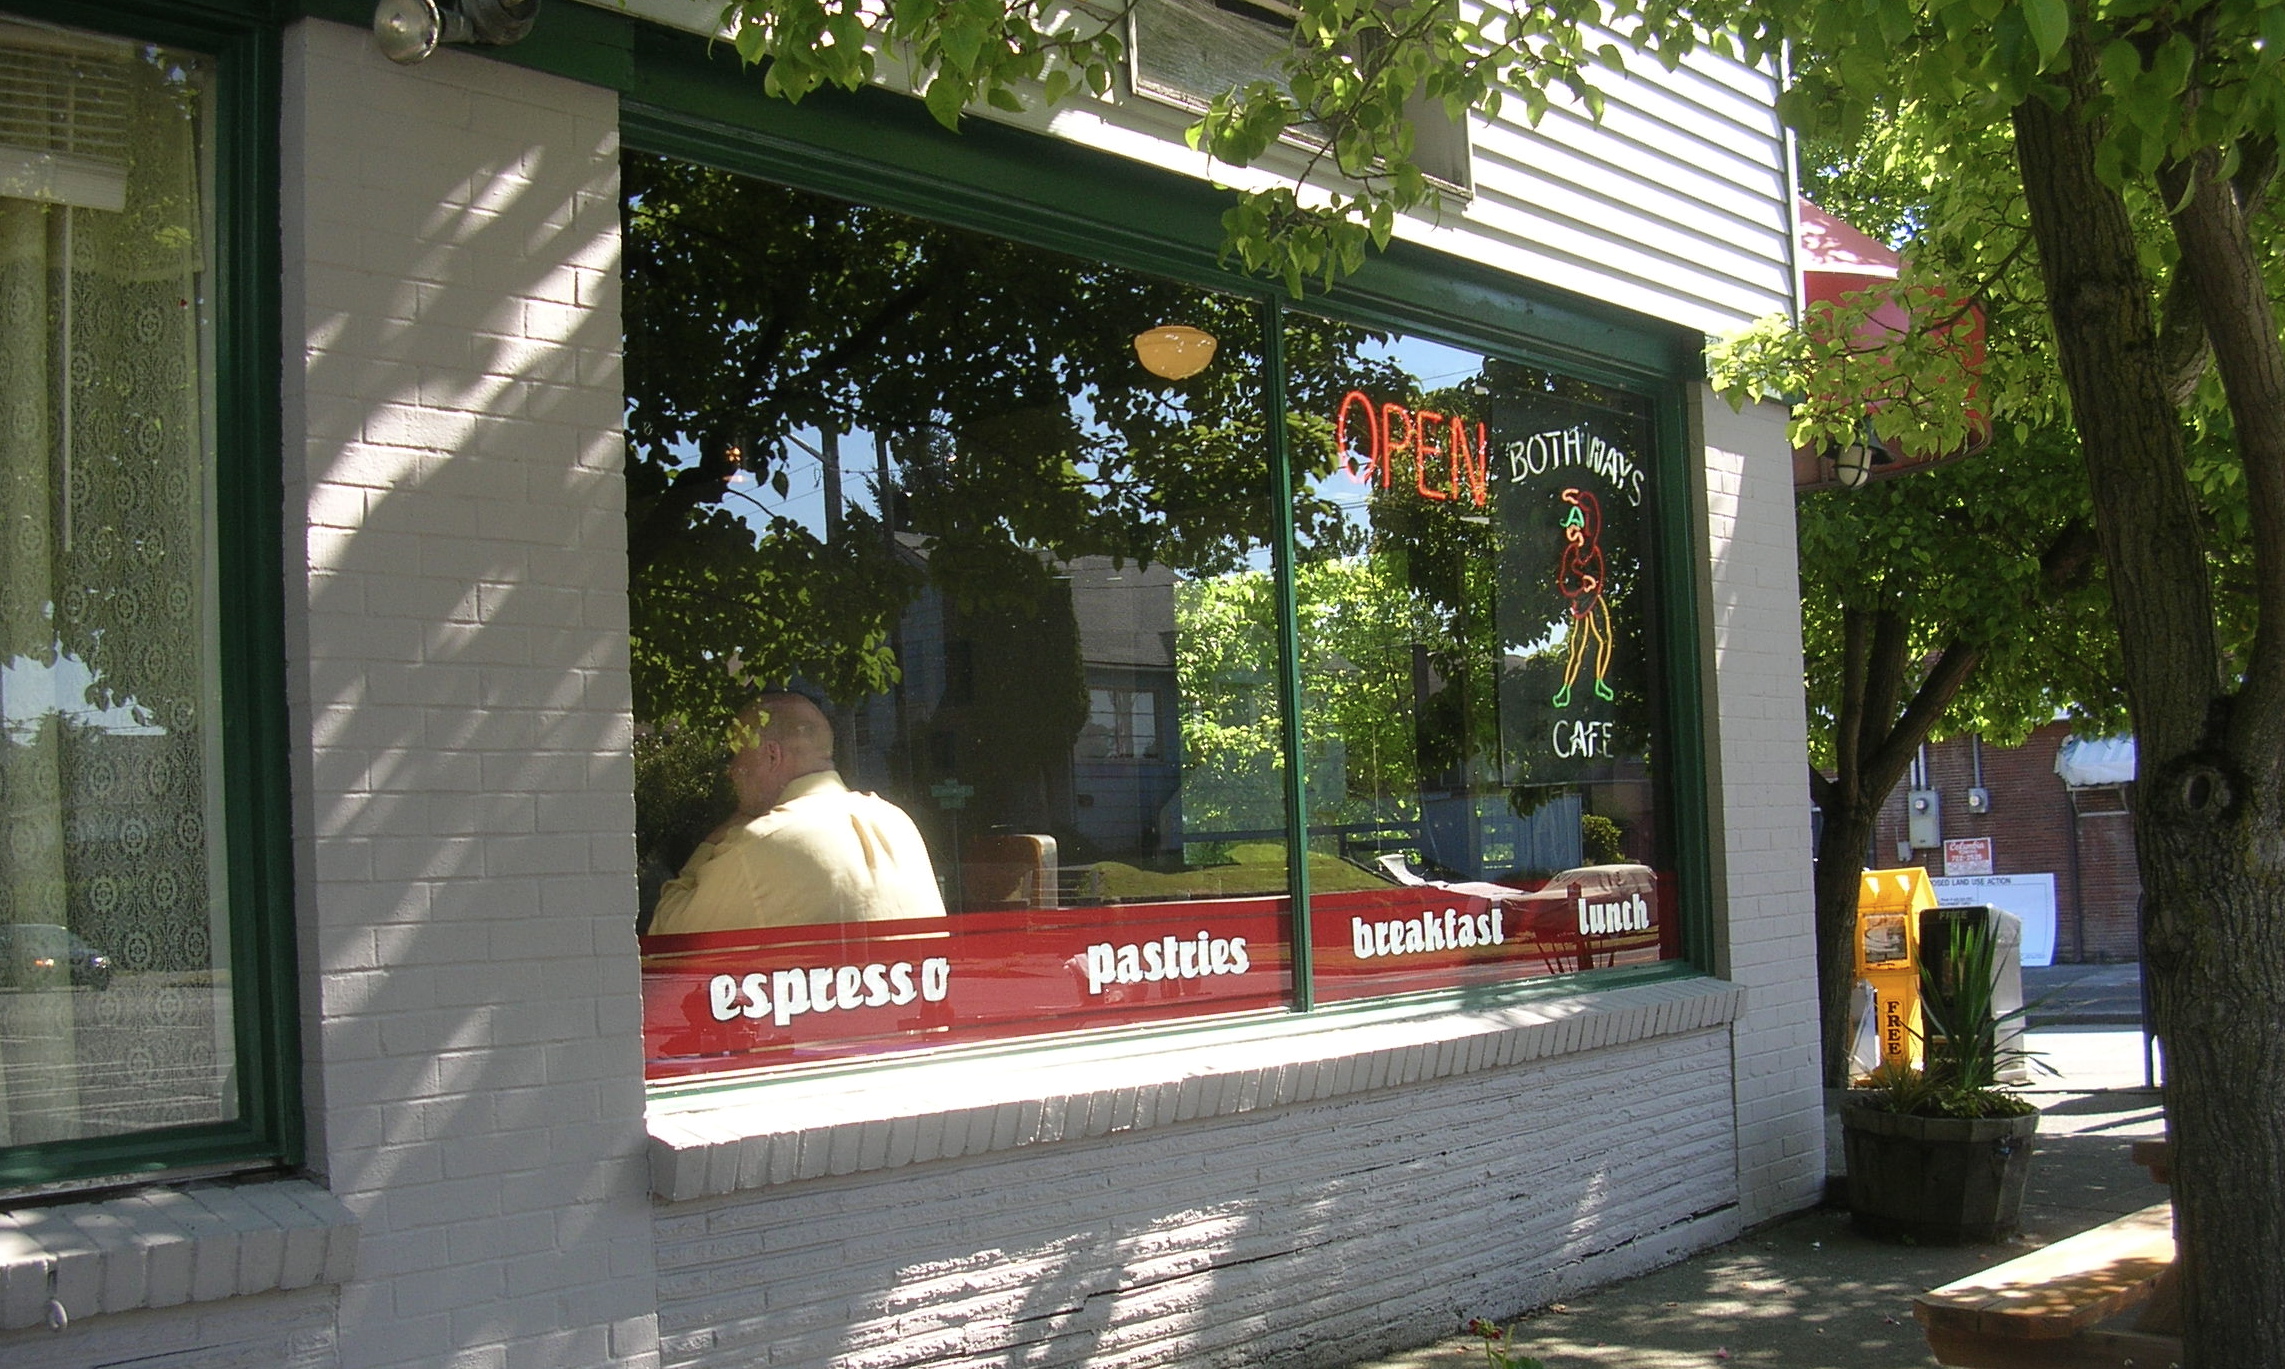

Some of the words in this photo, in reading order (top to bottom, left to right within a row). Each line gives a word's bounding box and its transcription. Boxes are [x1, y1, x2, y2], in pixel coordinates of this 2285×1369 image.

[1338, 390, 1486, 507] OPEN
[1507, 429, 1582, 483] BOTH
[1586, 431, 1645, 507] WAYS
[1553, 719, 1614, 759] CAFE
[1951, 878, 1970, 887] LAND
[1971, 877, 1984, 886] USE
[1987, 877, 2011, 886] ACTION
[1351, 907, 1504, 960] breakfast
[1578, 893, 1649, 936] lunch
[710, 957, 950, 1026] espresso
[1087, 930, 1250, 994] pastries
[1886, 1000, 1902, 1055] FREE
